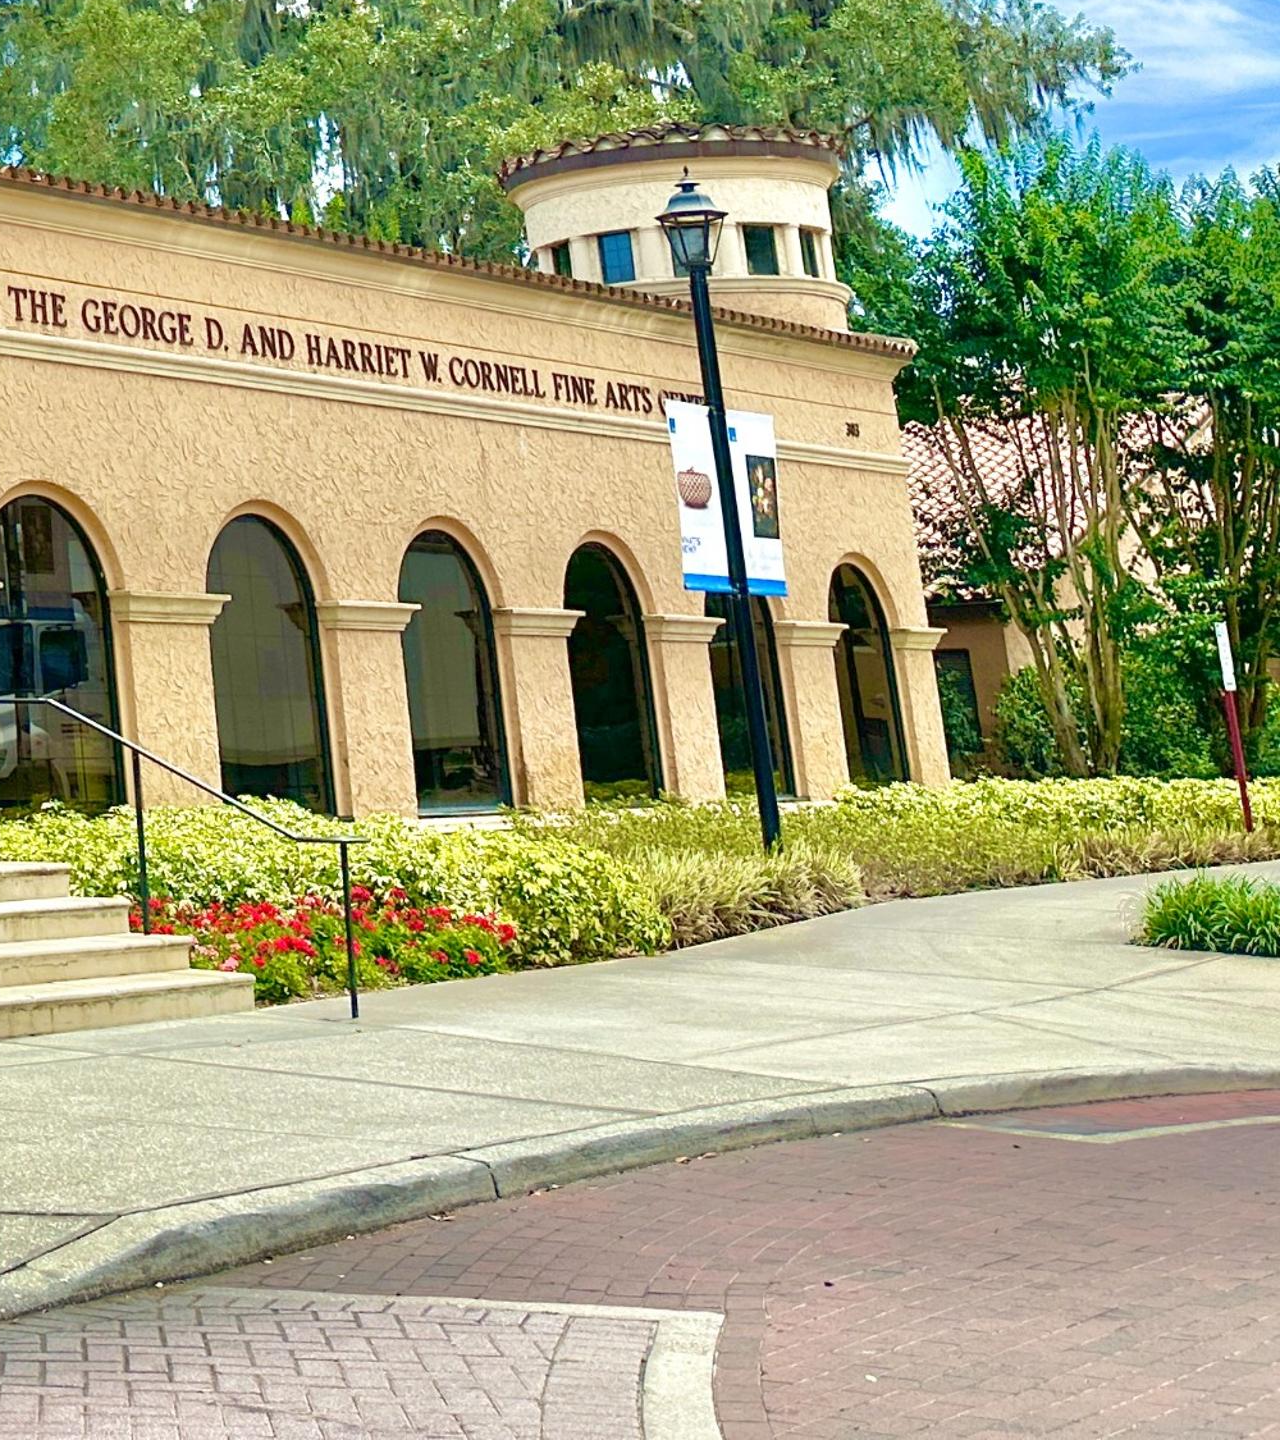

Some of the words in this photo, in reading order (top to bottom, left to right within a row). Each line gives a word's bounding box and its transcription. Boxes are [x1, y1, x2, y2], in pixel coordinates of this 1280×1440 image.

[7, 285, 67, 328] THE
[81, 298, 194, 346] GEORGE
[204, 316, 229, 351] D.
[240, 323, 295, 361] AND
[305, 333, 412, 379] HARRIET
[418, 350, 442, 383] W.
[448, 356, 546, 399] CORNELL
[552, 372, 598, 406] FINE
[605, 381, 653, 414] ARTS
